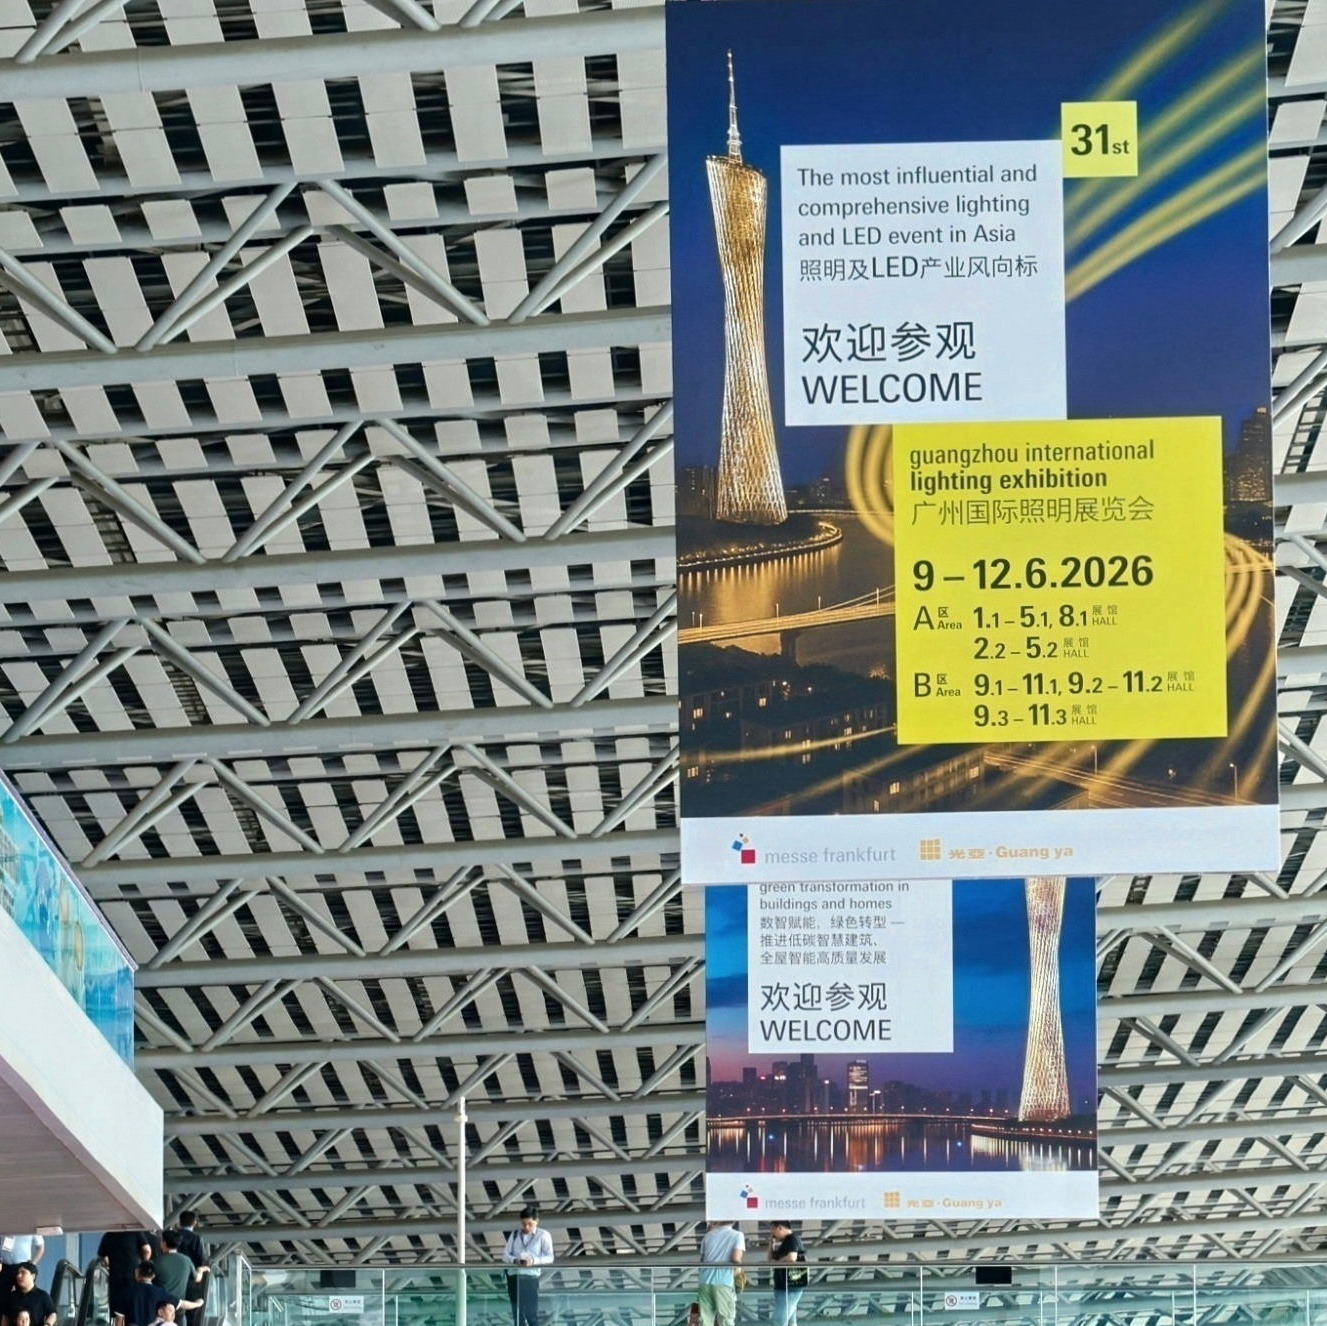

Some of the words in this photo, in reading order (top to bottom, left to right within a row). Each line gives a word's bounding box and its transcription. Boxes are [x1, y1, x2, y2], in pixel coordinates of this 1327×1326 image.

[1070, 122, 1129, 156] 31st
[797, 167, 834, 187] The
[840, 168, 890, 186] most
[896, 165, 994, 184] influential
[1000, 164, 1037, 182] and
[798, 197, 949, 218] comprehensive
[955, 195, 1030, 216] lighting
[798, 227, 835, 247] and
[842, 226, 882, 246] LED
[888, 227, 943, 245] event
[950, 225, 967, 243] in
[973, 224, 1016, 243] Asia
[799, 255, 1039, 282] 照明及LED产业风向标
[802, 322, 976, 364] 欢迎参观
[802, 372, 982, 405] WELCOME
[909, 442, 1019, 469] guangzhou
[1025, 439, 1154, 462] international
[910, 469, 992, 495] lighting
[999, 468, 1107, 489] exhibition
[911, 494, 1155, 526] 广州国际照明展览会
[937, 619, 963, 630] Area
[1092, 617, 1118, 626] HALL
[1063, 649, 1089, 658] HALL
[936, 686, 961, 697] Area
[1167, 682, 1194, 692] HALL
[1071, 716, 1096, 725] HALL
[764, 848, 817, 865] messe
[823, 846, 896, 864] frankfurt
[1053, 845, 1074, 860] ya
[759, 882, 795, 896] green
[799, 881, 892, 894] transformation
[897, 881, 910, 892] in
[759, 896, 818, 913] buildings
[822, 897, 845, 910] and
[849, 896, 892, 910] homes
[759, 950, 887, 965] 全屋智能高质量发展
[760, 982, 887, 1012] 欢迎参观
[760, 1019, 892, 1042] WELCOME
[764, 1196, 806, 1210] messe
[809, 1195, 866, 1209] frankfurt
